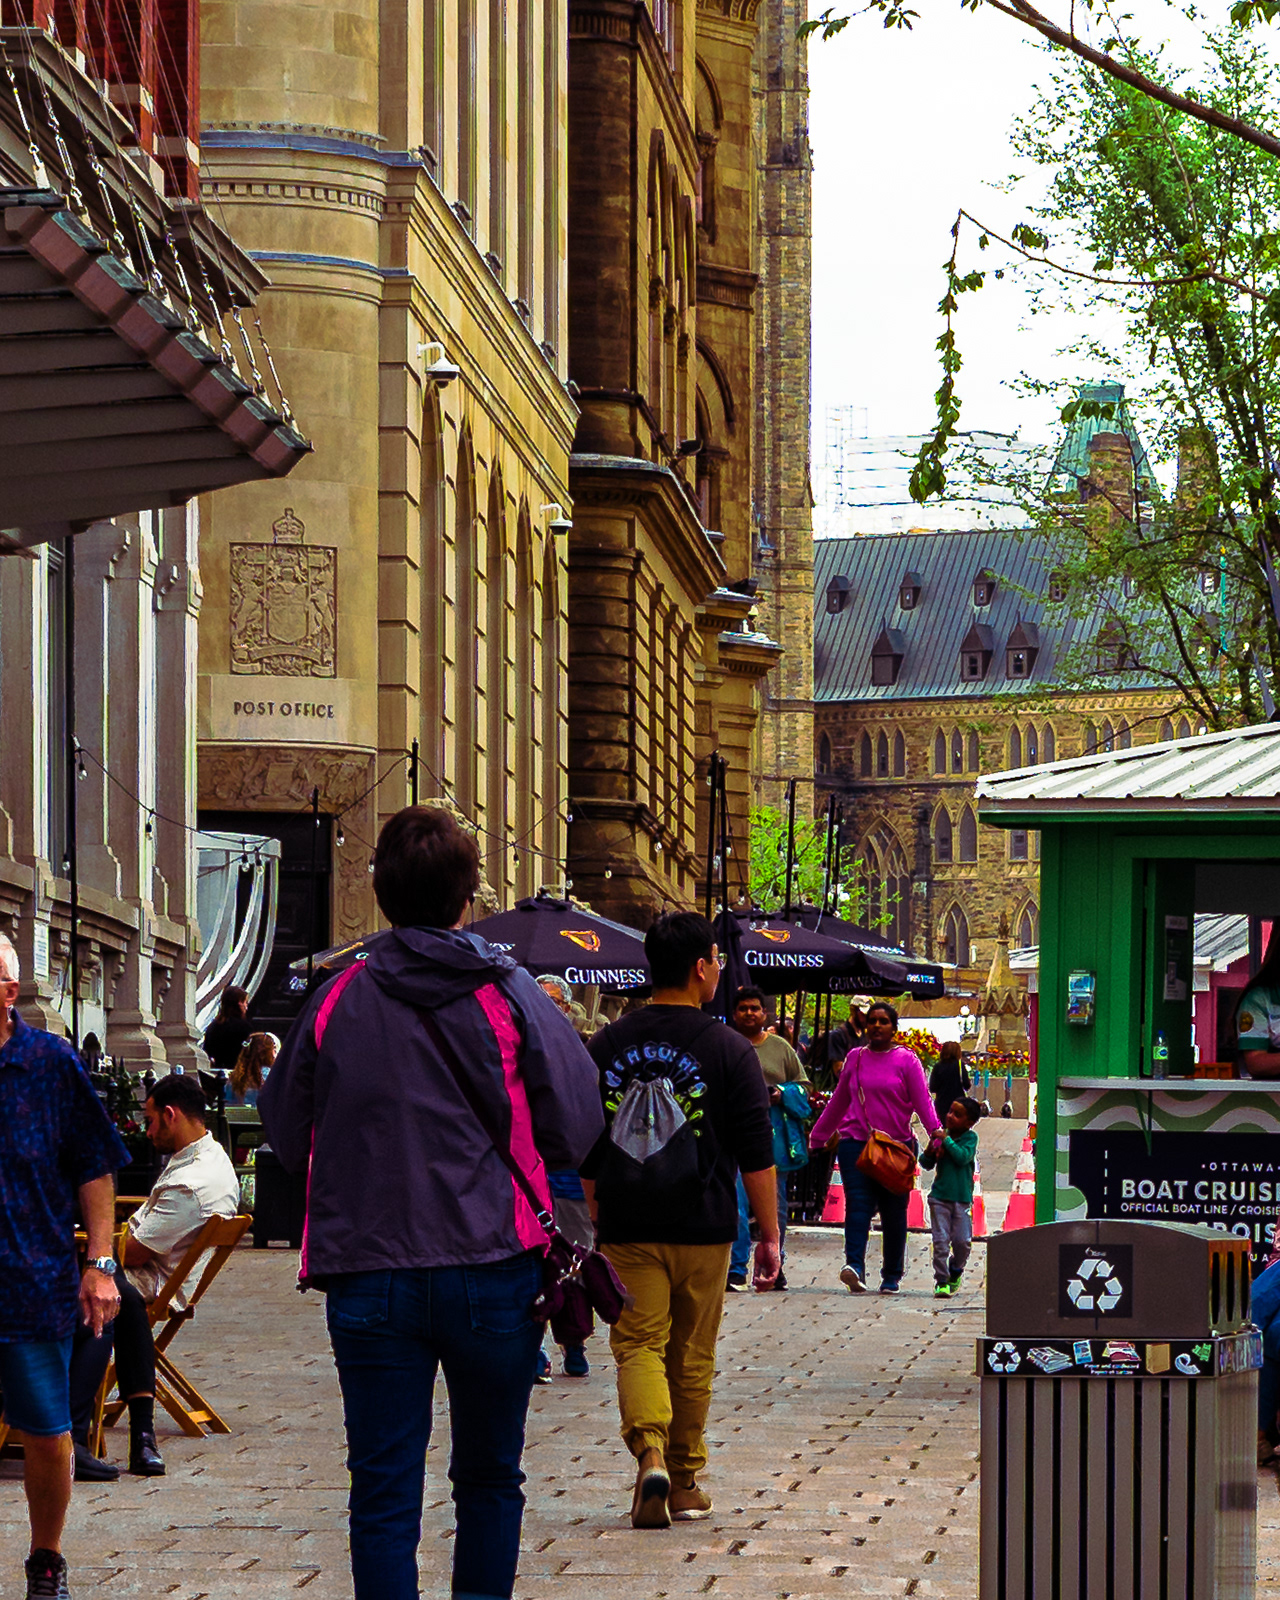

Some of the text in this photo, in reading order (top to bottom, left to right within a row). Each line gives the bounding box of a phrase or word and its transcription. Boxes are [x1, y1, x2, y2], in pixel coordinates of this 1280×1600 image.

[233, 701, 334, 719] POST OFFICE
[744, 950, 824, 968] GUINNESS
[564, 966, 646, 984] GUINNESS
[829, 975, 882, 992] GUINNESS
[1209, 1162, 1274, 1172] OTTAWA
[1121, 1179, 1188, 1200] BOAT
[1120, 1202, 1169, 1213] OFFICIAL
[1172, 1203, 1201, 1214] BOAT
[1204, 1204, 1228, 1215] LINE
